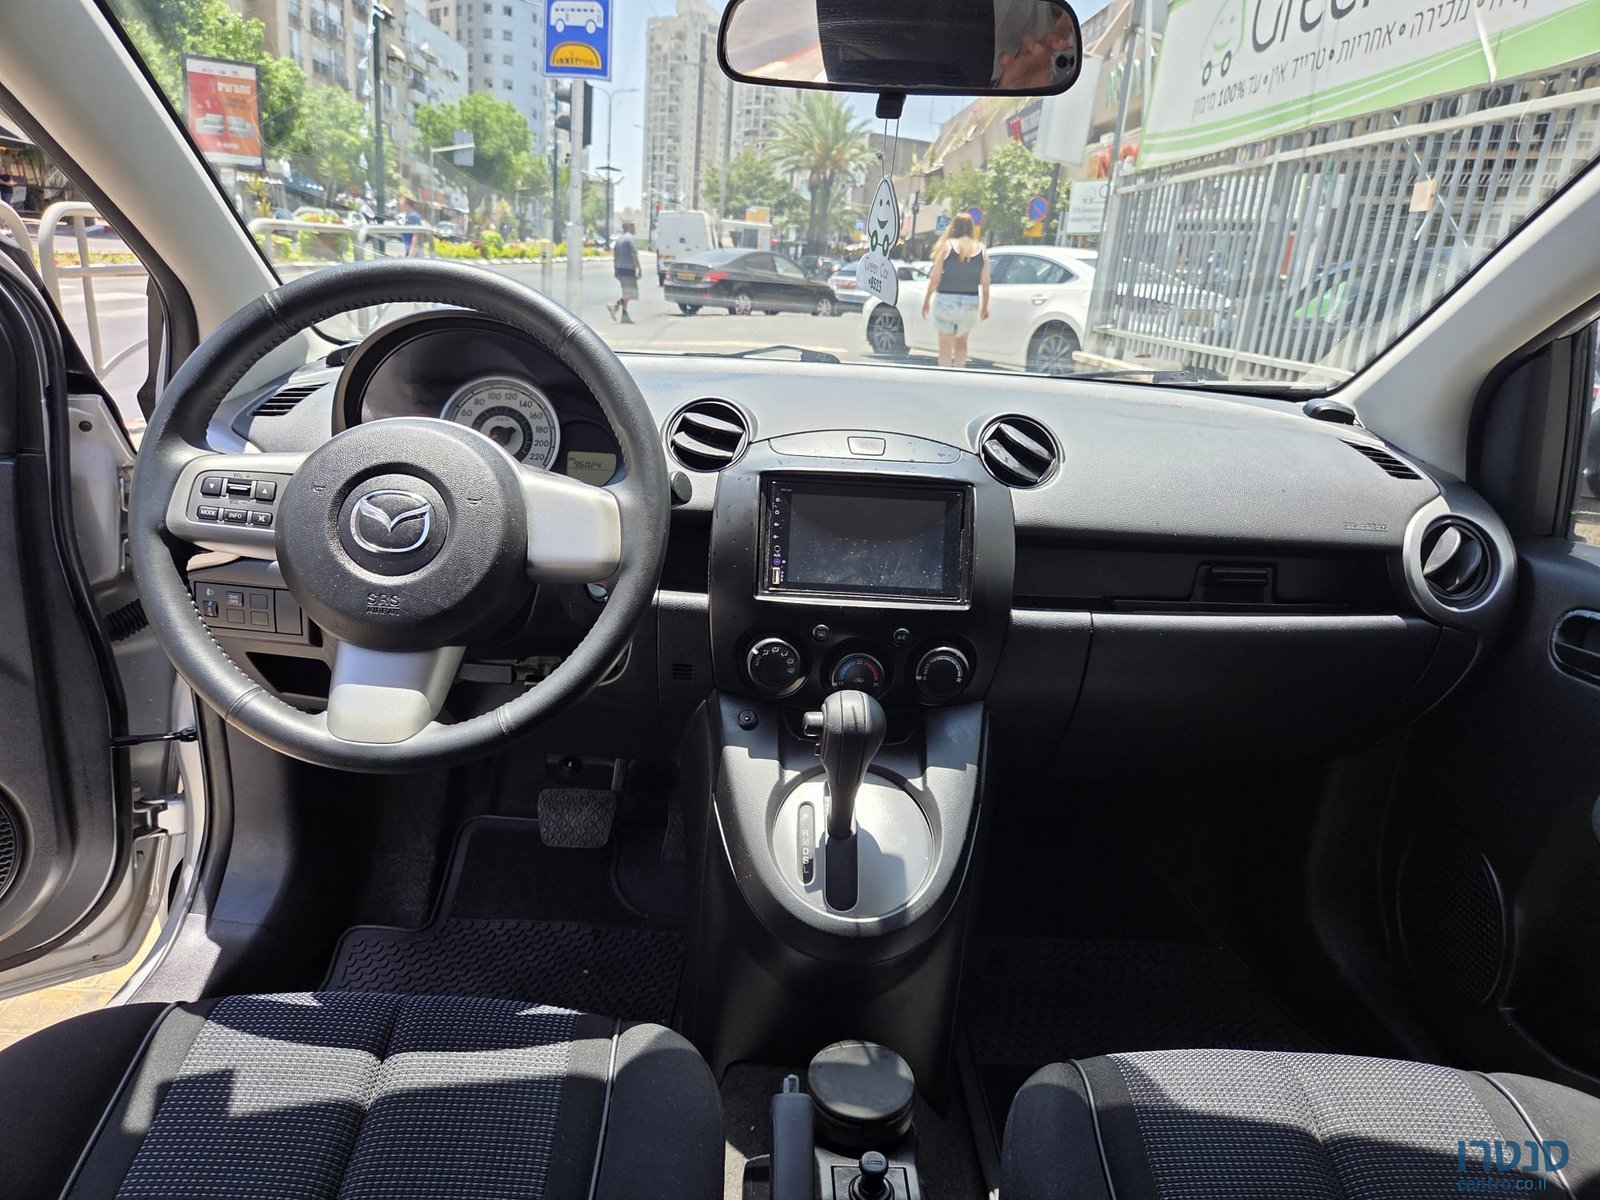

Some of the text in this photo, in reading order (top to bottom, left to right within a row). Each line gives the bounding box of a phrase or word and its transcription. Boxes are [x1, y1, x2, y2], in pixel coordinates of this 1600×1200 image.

[1192, 0, 1473, 121] מכירה אחריות טרייד אין עד 100% מימון
[488, 392, 502, 400] 100
[504, 392, 518, 401] 120
[473, 398, 485, 406] 80
[519, 400, 533, 409] 140
[461, 409, 473, 418] 60
[530, 412, 543, 420] 160
[535, 425, 549, 434] 180
[534, 439, 550, 447] 200
[529, 453, 545, 461] 220
[367, 593, 400, 606] SRS
